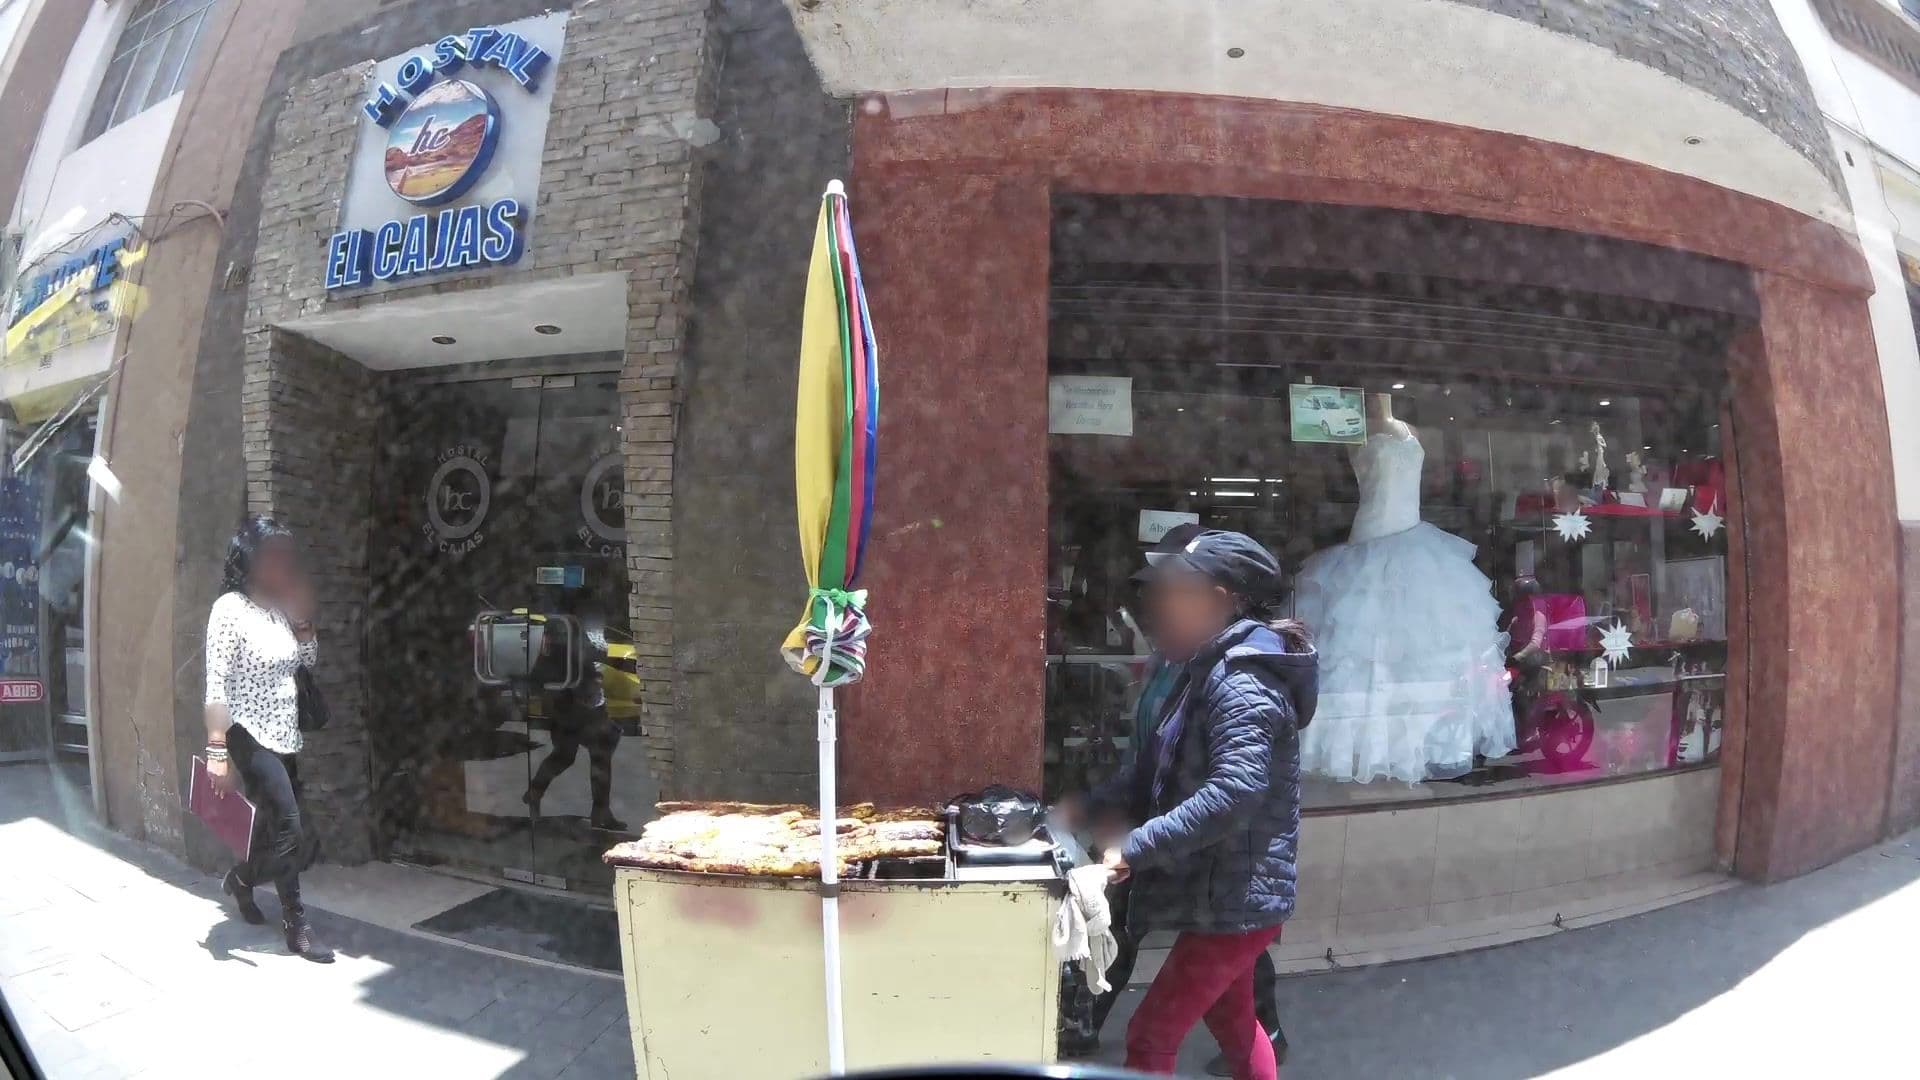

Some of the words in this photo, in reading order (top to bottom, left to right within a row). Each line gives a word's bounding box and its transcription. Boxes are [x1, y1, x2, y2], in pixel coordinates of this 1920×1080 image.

[363, 27, 548, 126] HOSTAL
[409, 114, 450, 155] hc
[324, 228, 366, 289] EL
[371, 198, 519, 281] CAJAS
[437, 444, 488, 466] HOSTAL
[422, 522, 435, 544] EL
[439, 531, 485, 555] CAJAS
[578, 525, 593, 549] EL
